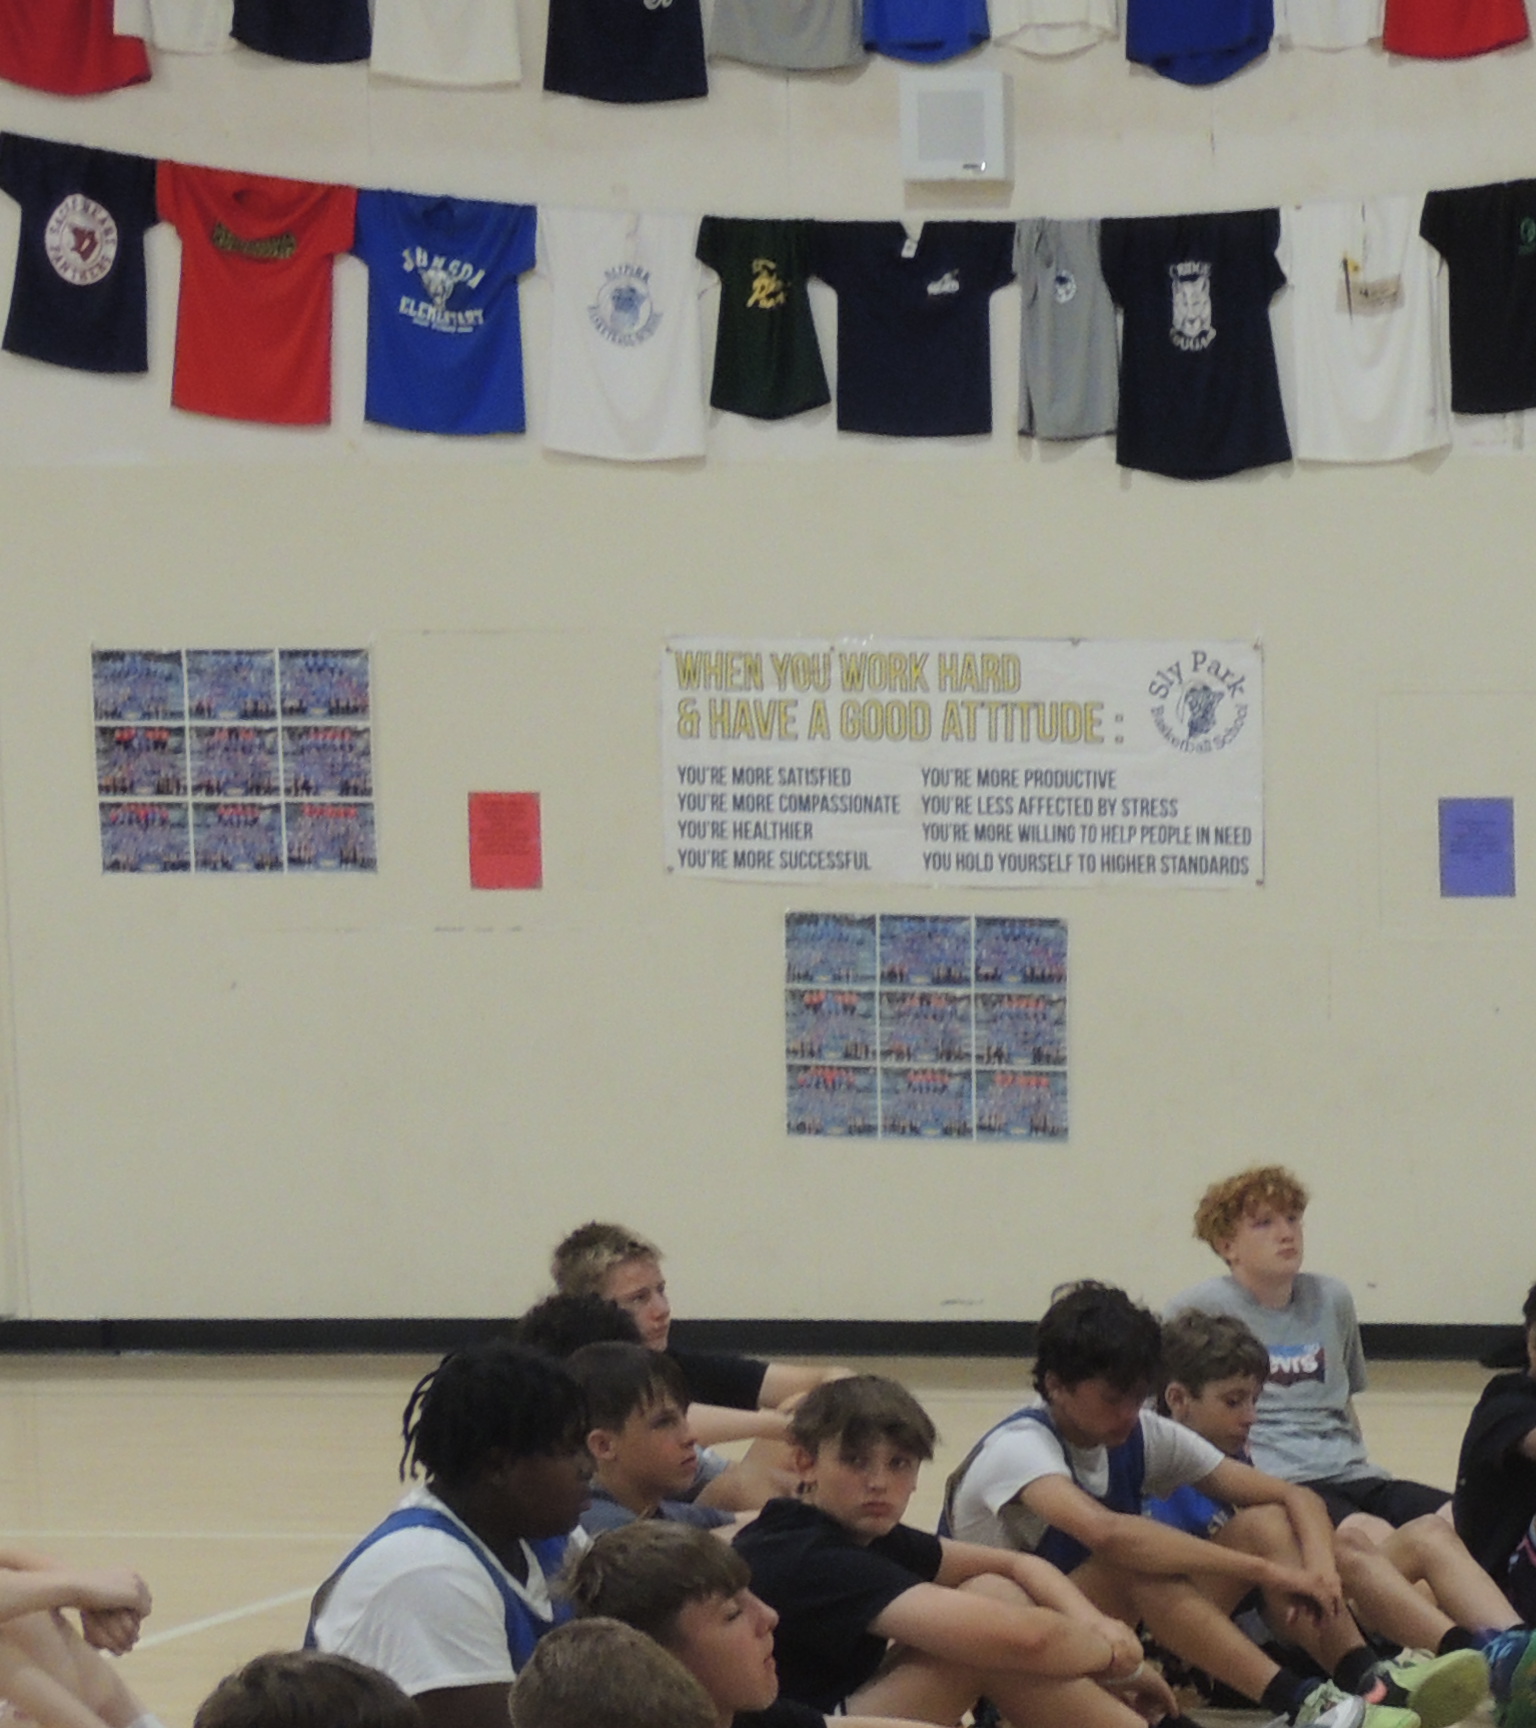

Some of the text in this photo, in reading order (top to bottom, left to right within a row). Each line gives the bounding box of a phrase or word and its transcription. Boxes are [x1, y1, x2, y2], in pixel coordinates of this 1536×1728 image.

[675, 651, 1021, 693] WHEN YOU WORK HARD
[1148, 650, 1246, 699] Sly Park
[677, 697, 700, 739] &
[709, 698, 798, 740] HAVE
[808, 699, 831, 741] A
[840, 699, 931, 742] GOOD
[941, 700, 1104, 744] ATTITUDE
[678, 766, 852, 788] YOU'RE MORE SATISFIED
[921, 767, 1117, 790] YOU'RE MORE PRODUCTIVE
[678, 792, 901, 815] YOU'RE MORE COMPASSIONATE
[921, 795, 1178, 818] YOU'RE LESS AFFECTED BY STRESS
[678, 820, 813, 841] YOU'RE HEALTHIER
[922, 822, 1252, 847] YOU'RE MORE WILLING TO HELP PEOPLE IN NEED
[678, 848, 872, 872] YOU'RE MORE SUCCESSFUL
[923, 851, 1250, 876] YOU HOLD YOURSELF TO HIGHER STANDARDS
